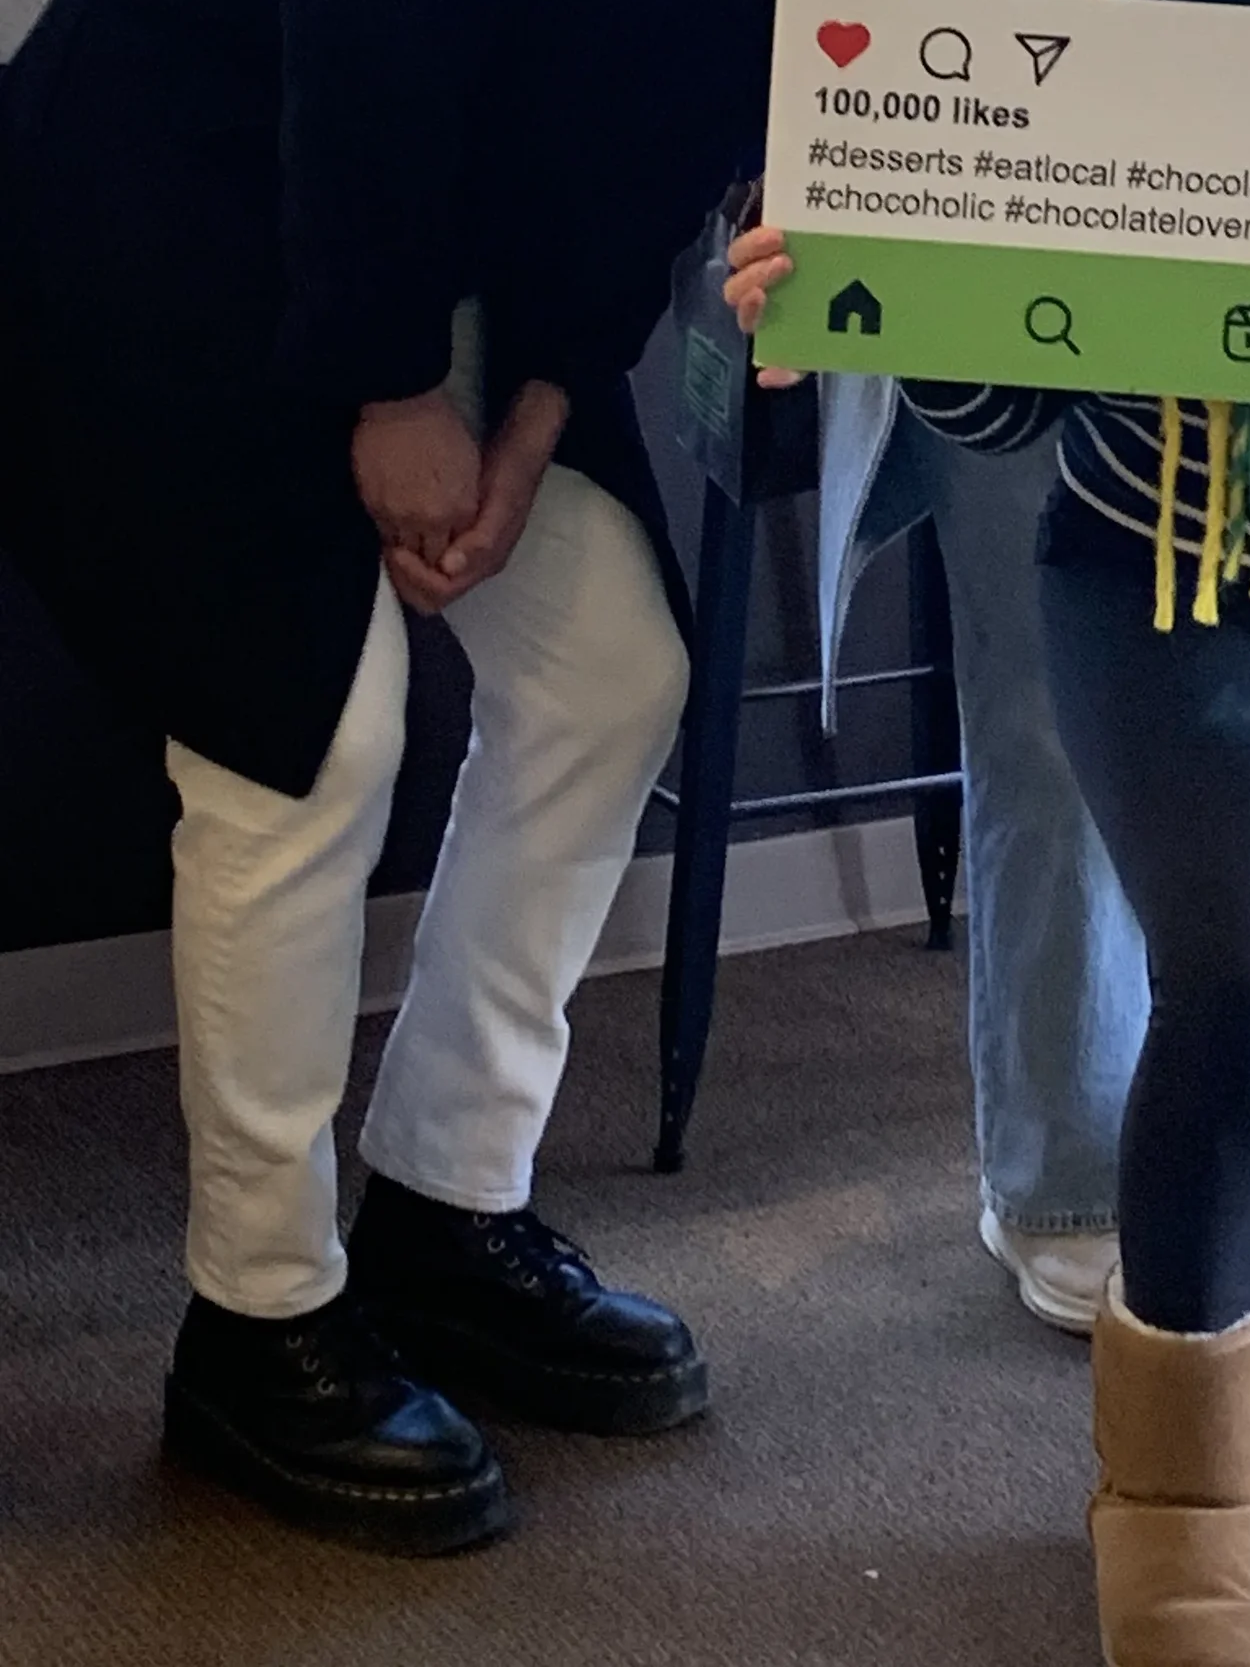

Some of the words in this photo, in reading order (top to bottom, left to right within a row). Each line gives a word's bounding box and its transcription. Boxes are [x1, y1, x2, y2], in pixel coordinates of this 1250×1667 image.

[814, 86, 942, 123] 100,000
[952, 95, 1031, 129] likes
[808, 138, 964, 177] #desserts
[973, 150, 1117, 189] #eatlocal
[805, 180, 995, 222] #chocoholic
